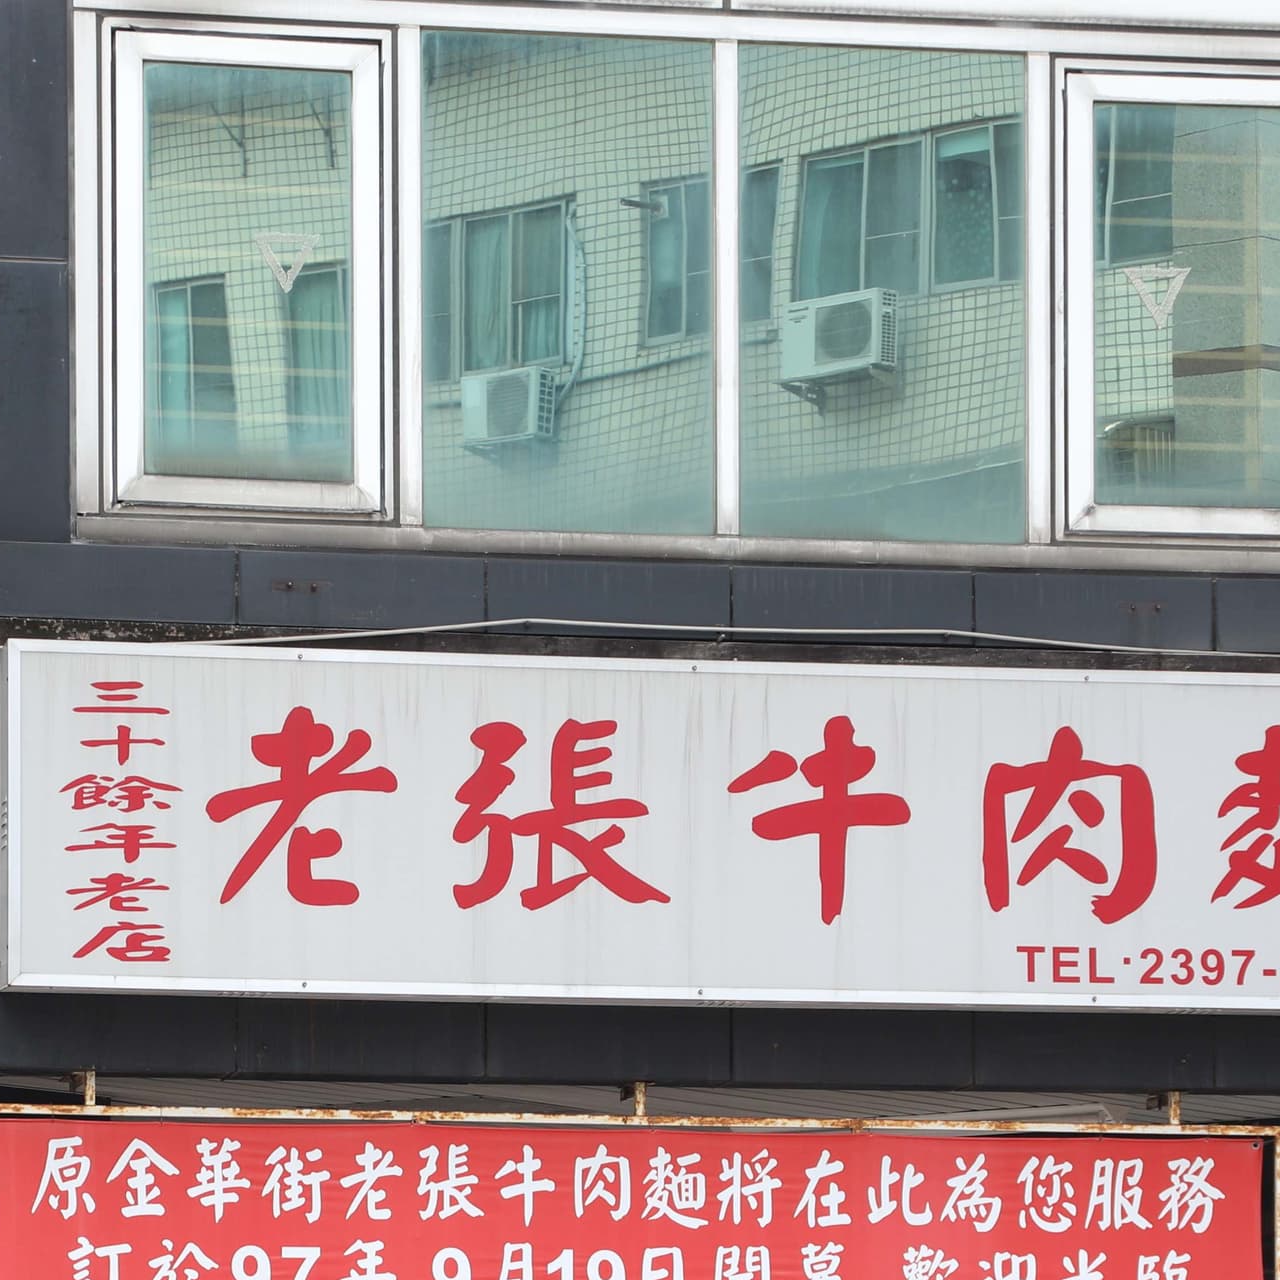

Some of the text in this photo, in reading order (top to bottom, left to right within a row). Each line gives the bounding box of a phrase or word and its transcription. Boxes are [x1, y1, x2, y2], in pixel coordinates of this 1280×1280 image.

[59, 681, 184, 963] 三十餘年老店
[31, 1135, 1226, 1234] 原金華街老張牛肉麵將在此為您服務
